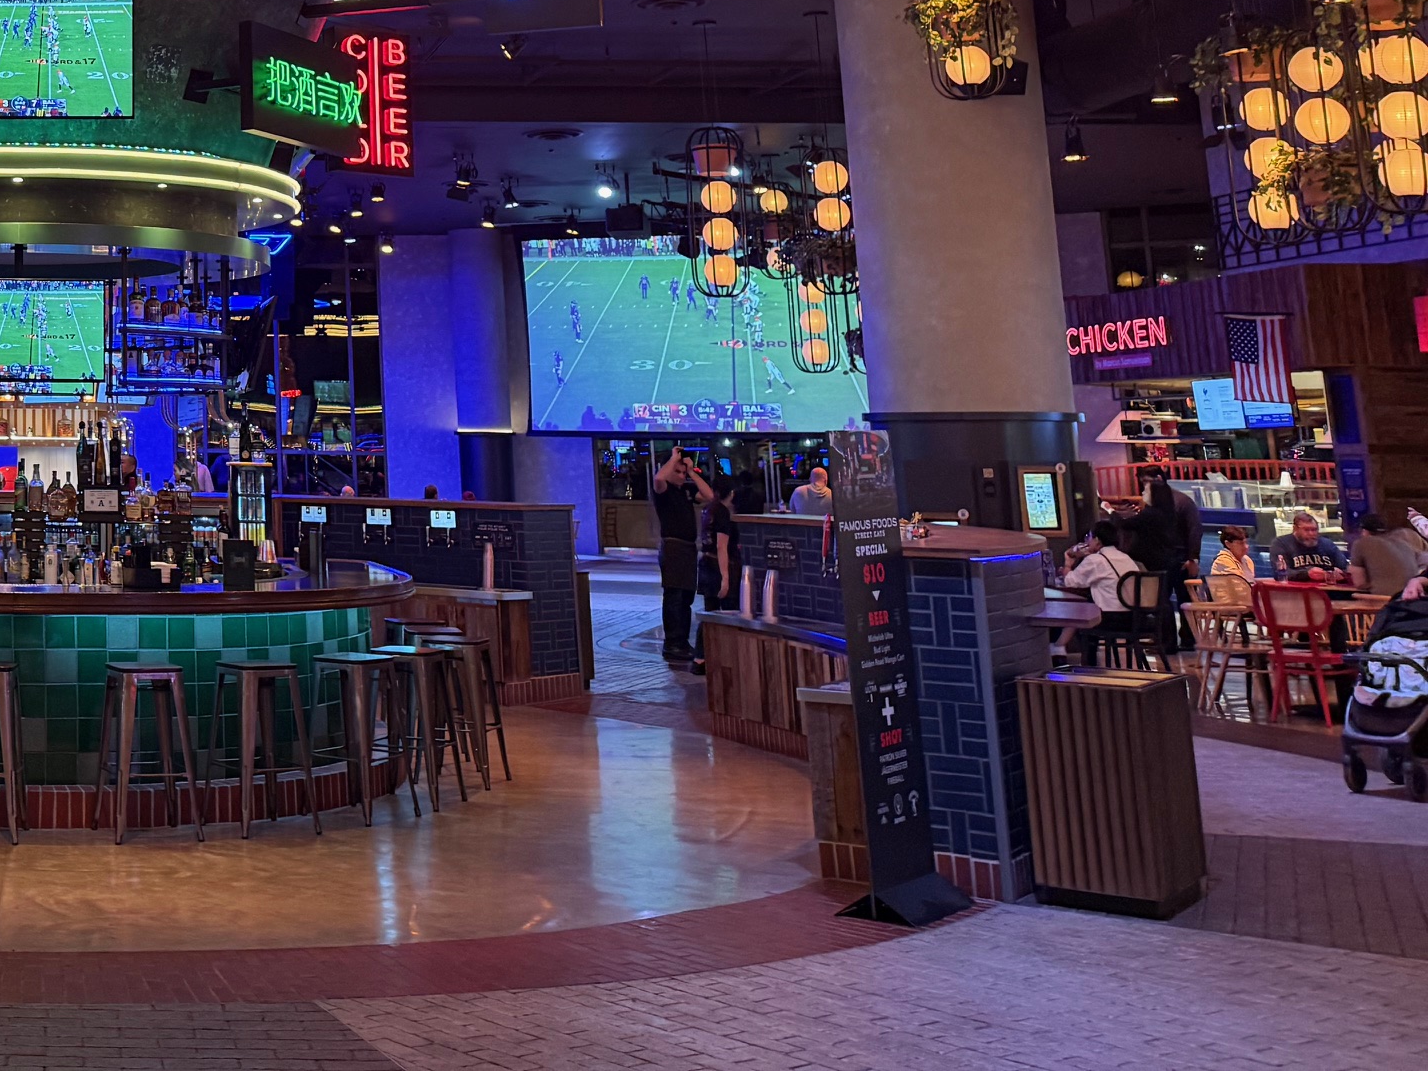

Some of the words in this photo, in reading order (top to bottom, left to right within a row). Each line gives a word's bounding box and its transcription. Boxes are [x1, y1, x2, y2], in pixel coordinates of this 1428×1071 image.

[384, 38, 410, 168] BEER
[1066, 316, 1167, 355] CHICKEN
[651, 404, 670, 413] CIN
[678, 405, 688, 416] 3
[725, 405, 734, 416] 7
[742, 405, 764, 413] BAL
[839, 520, 871, 532] FAMOUS
[871, 517, 898, 529] FOODS
[855, 543, 888, 557] SPECIAL
[1293, 554, 1332, 568] BEARS
[863, 562, 885, 585] $10
[868, 610, 889, 627] BEER
[880, 729, 902, 747] SHOT
